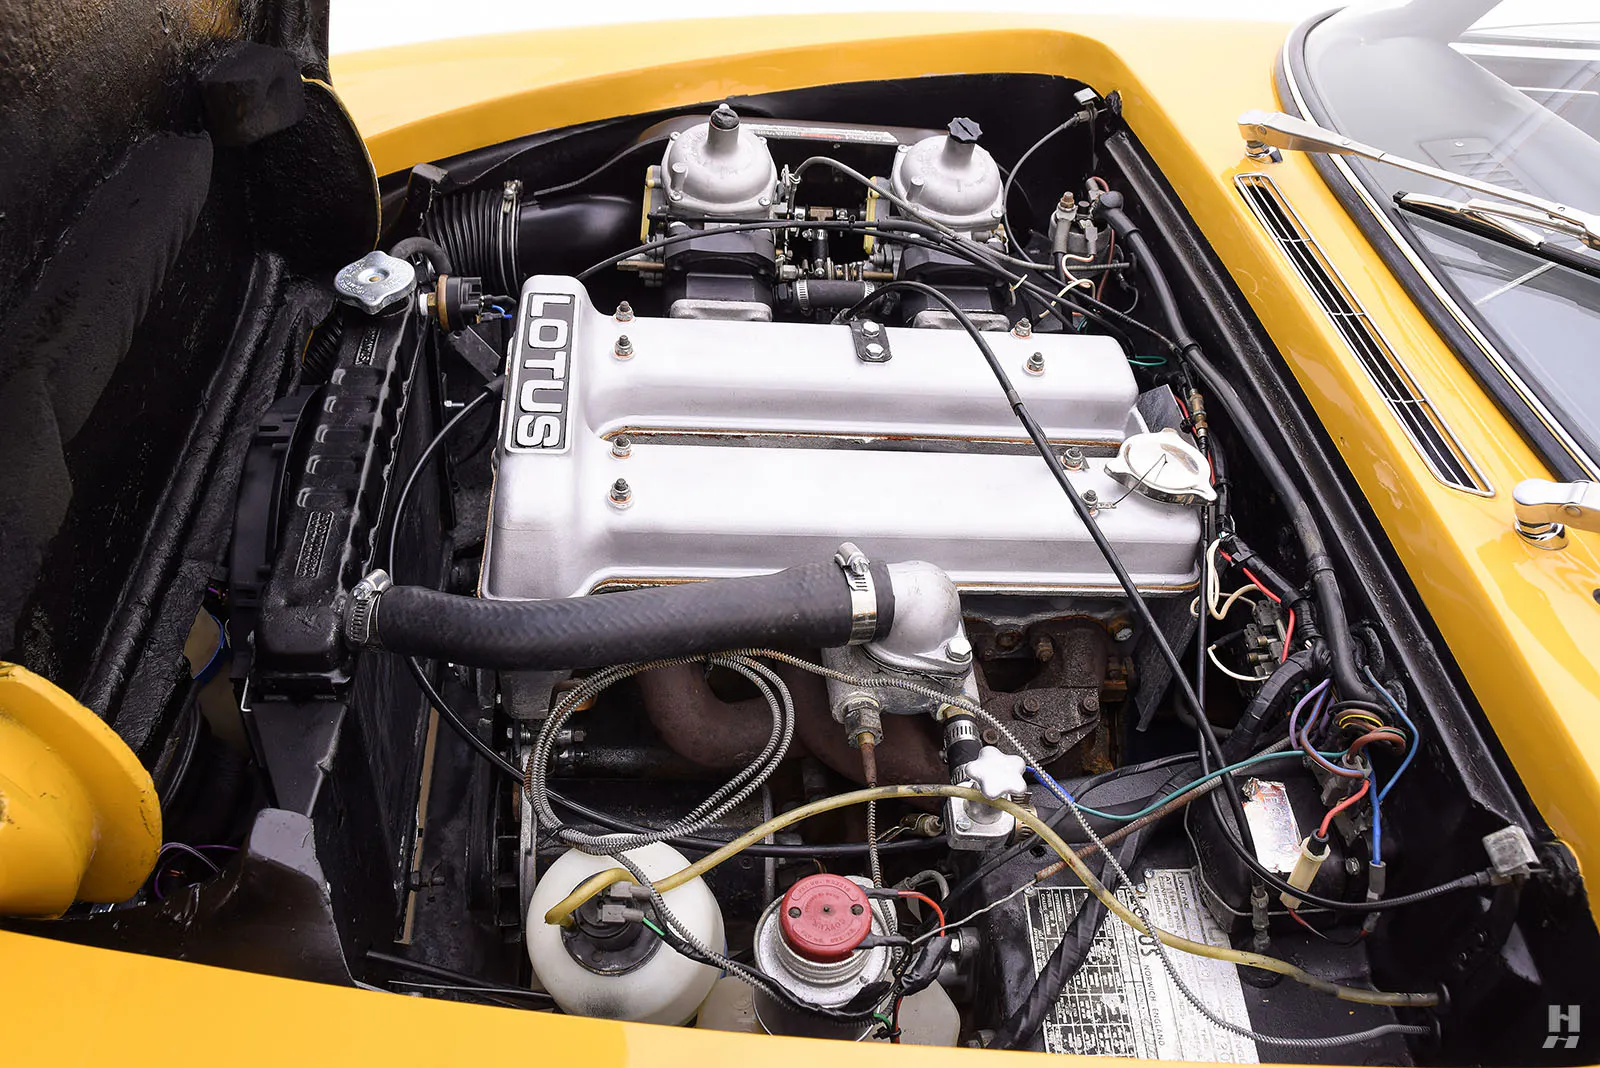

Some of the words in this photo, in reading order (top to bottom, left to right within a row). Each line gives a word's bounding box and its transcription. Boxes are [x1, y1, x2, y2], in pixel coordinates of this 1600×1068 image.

[516, 294, 571, 448] LOTUS
[1131, 894, 1157, 958] LOUS
[1143, 964, 1156, 1002] NORWICH
